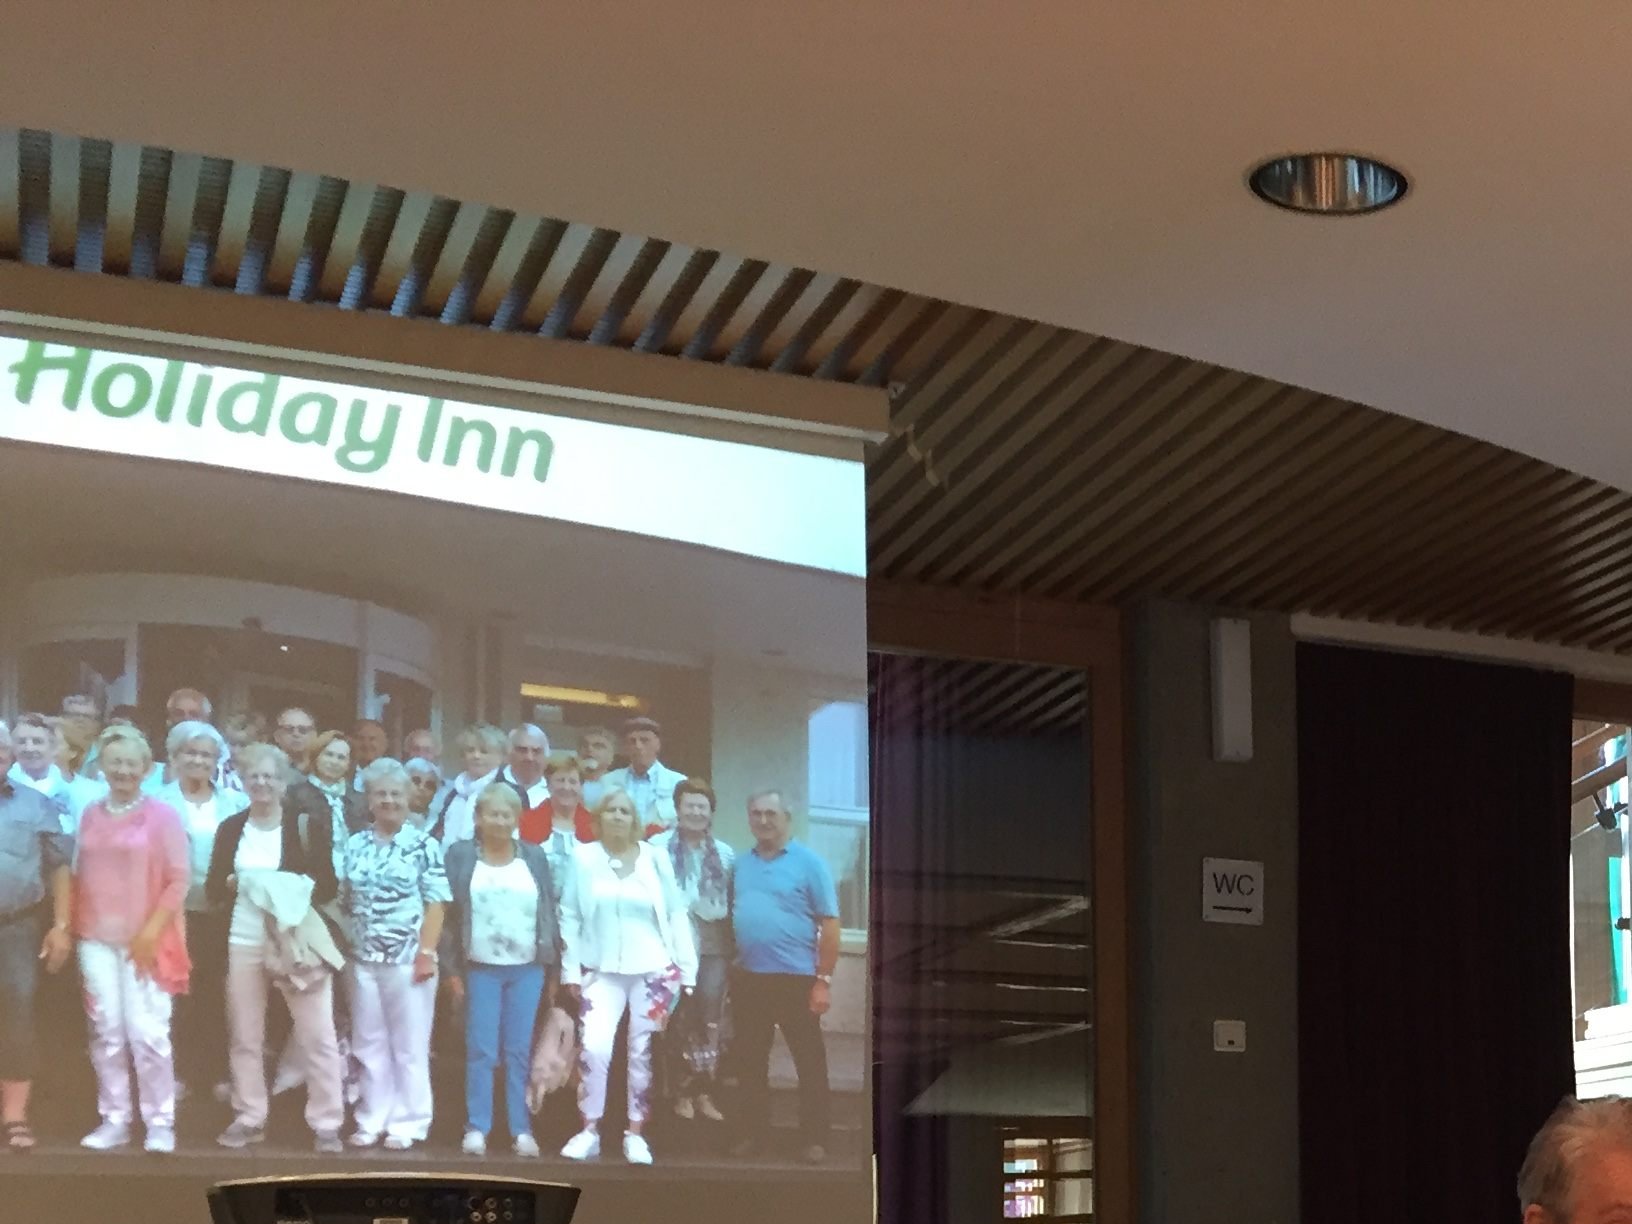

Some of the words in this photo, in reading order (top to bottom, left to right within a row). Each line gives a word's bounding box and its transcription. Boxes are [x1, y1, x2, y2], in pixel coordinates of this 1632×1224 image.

[7, 340, 402, 473] Holiday
[417, 396, 555, 483] Inn
[1212, 871, 1255, 896] WC
